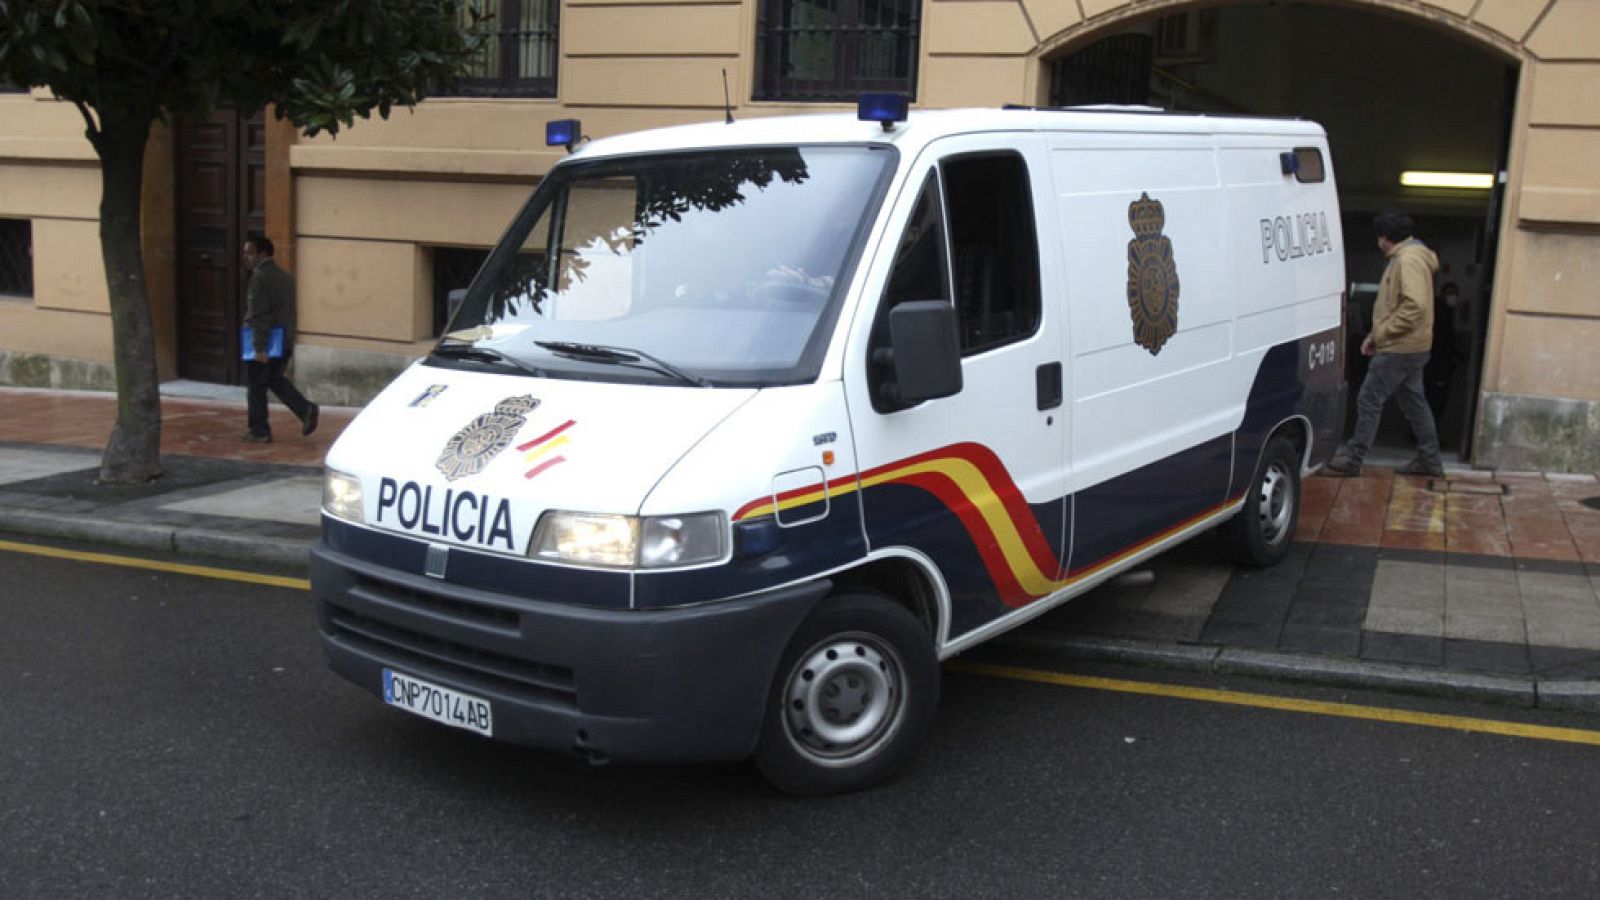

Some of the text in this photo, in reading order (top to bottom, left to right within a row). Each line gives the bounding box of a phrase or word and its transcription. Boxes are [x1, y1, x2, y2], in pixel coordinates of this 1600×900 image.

[1260, 211, 1332, 264] POLICIA
[377, 477, 514, 549] POLICIA
[393, 676, 489, 730] CNP7014AB
